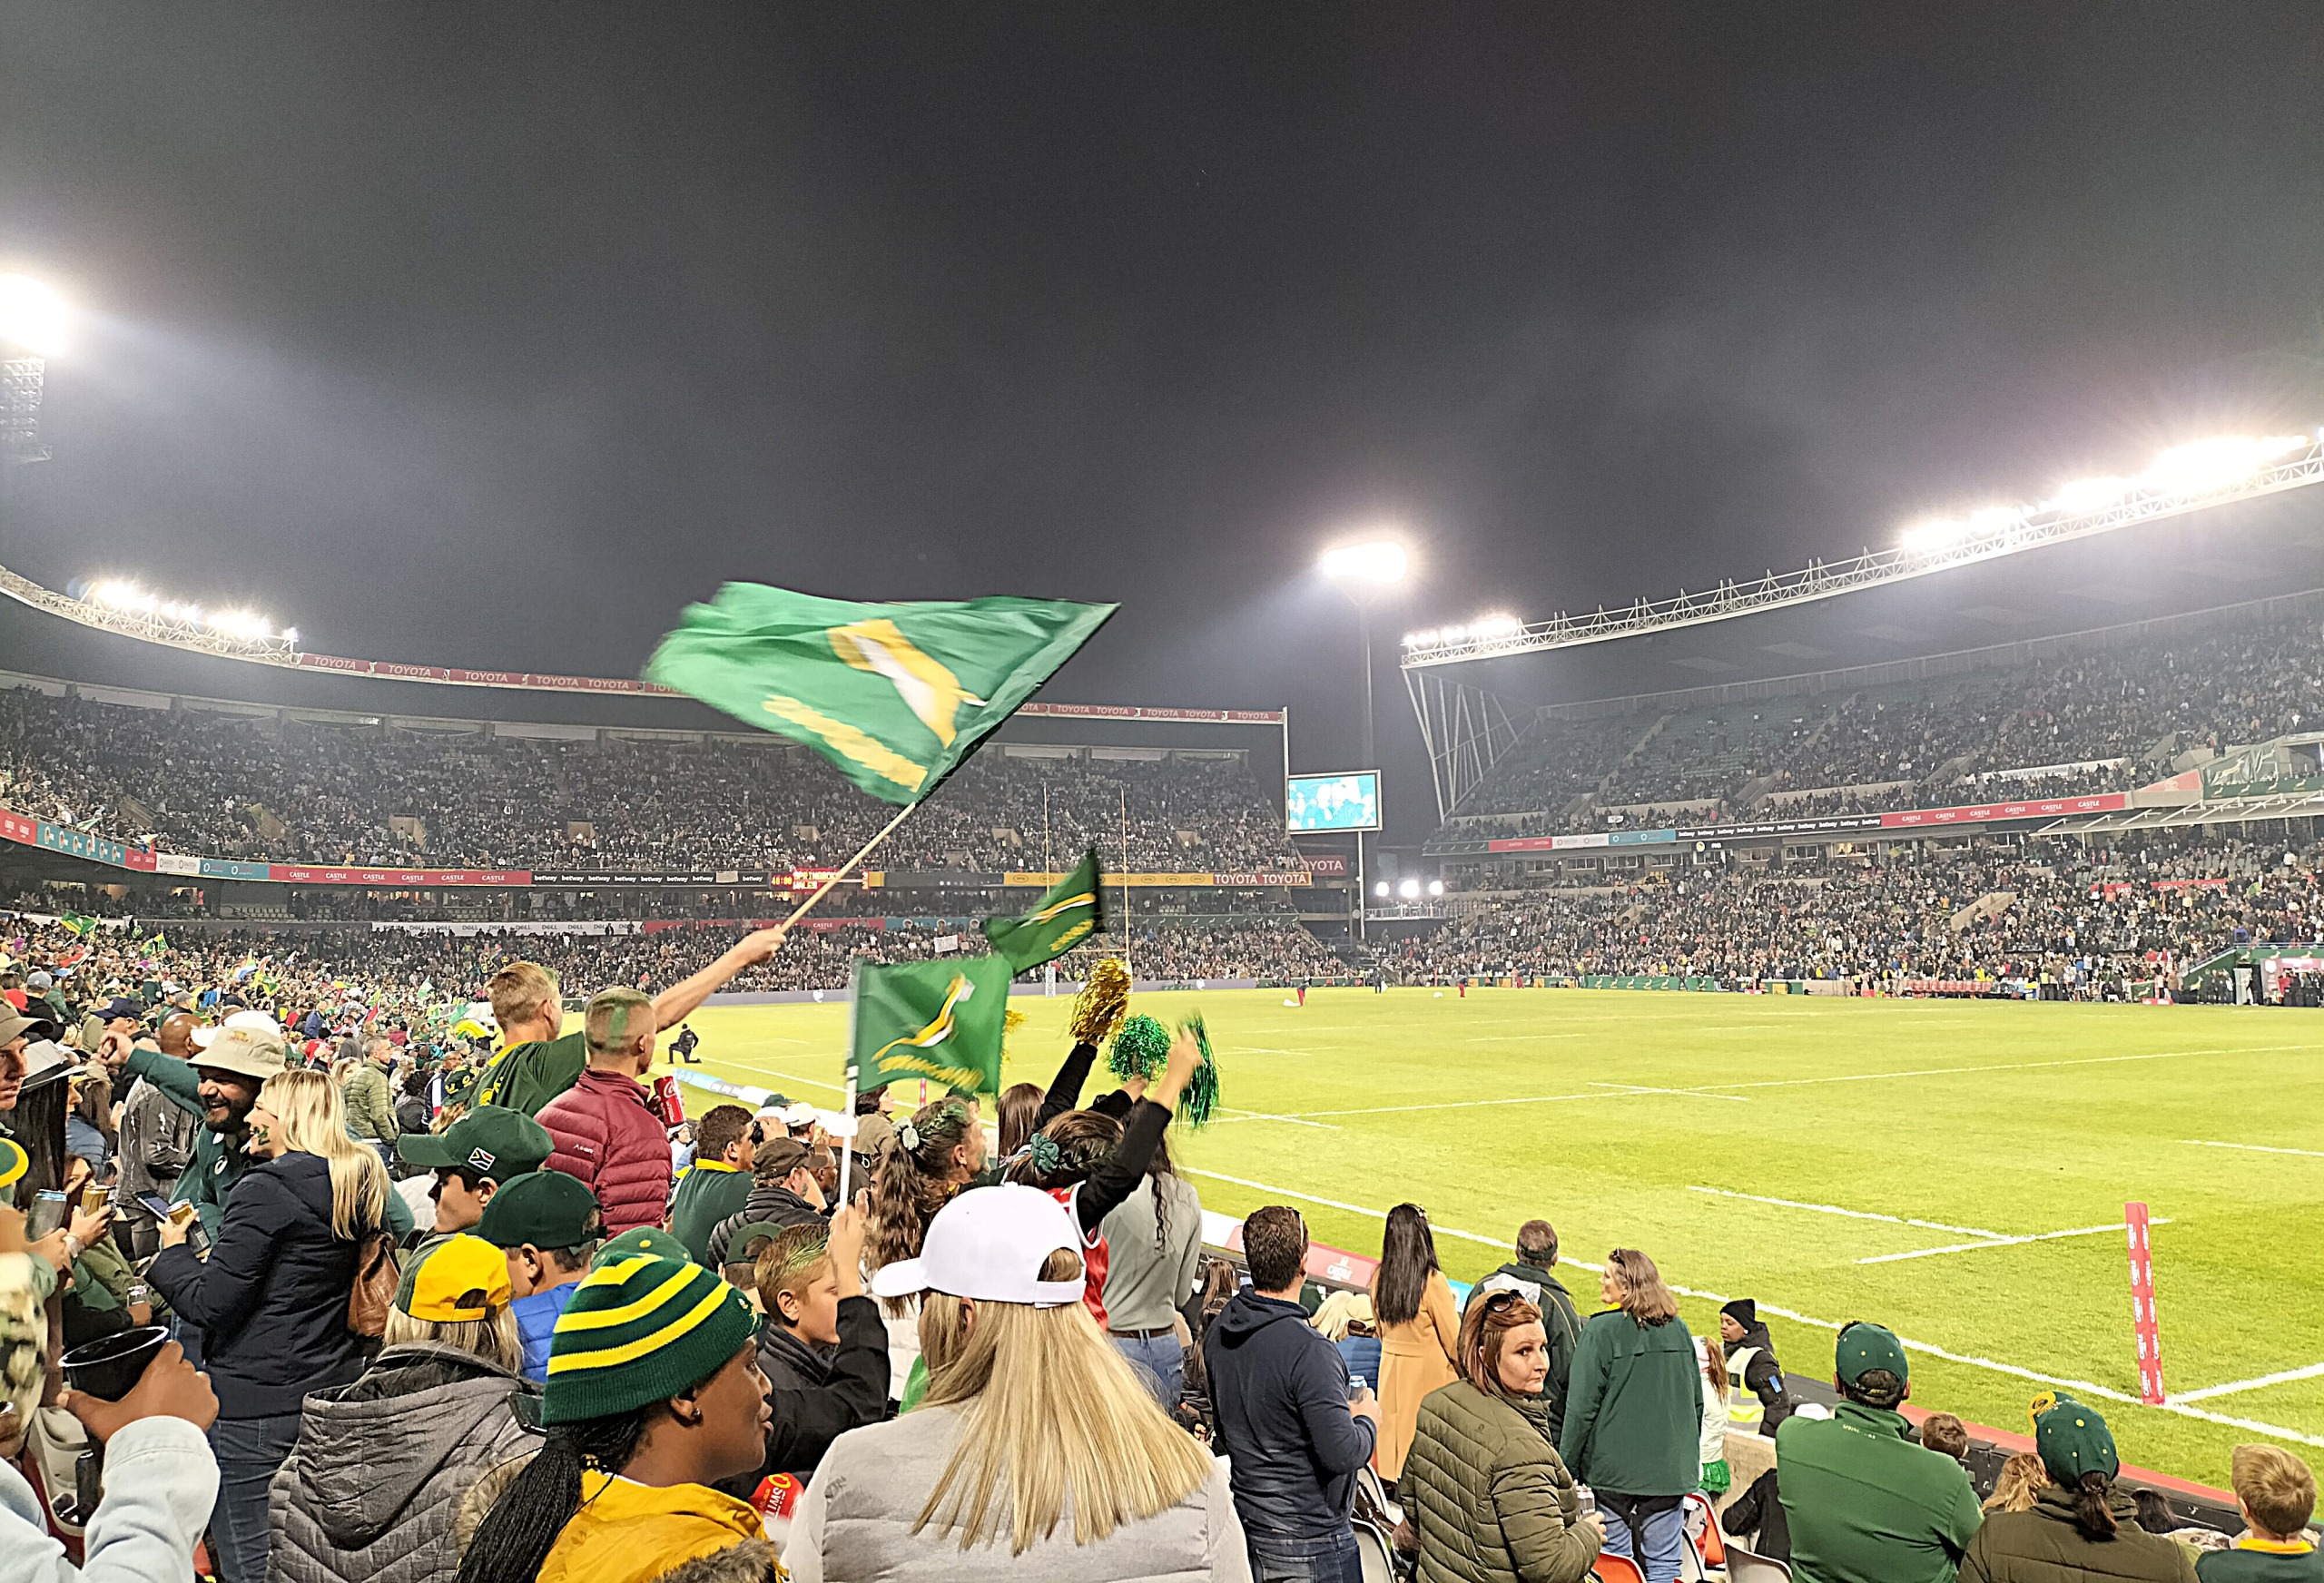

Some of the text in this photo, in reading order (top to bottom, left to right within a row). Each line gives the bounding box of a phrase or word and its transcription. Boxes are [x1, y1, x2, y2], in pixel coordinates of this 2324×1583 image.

[314, 656, 357, 670] TOYOTA
[388, 664, 431, 677] TOYOTA
[464, 672, 508, 683] TOYOTA
[536, 676, 578, 687] TOYOTA
[588, 679, 629, 690] TOYOTA
[1058, 704, 1089, 714] TOYOTA
[1097, 707, 1128, 715] TOYOTA
[1147, 709, 1178, 717] TOYOTA
[1185, 711, 1216, 719] TOYOTA
[1237, 712, 1269, 720] TOYOTA
[793, 871, 842, 880] SPRINGBOK
[1215, 874, 1306, 884] TOYOTA TOYOTA
[2127, 1223, 2136, 1250] CASTLE
[2131, 1260, 2139, 1286] CASTLE
[2133, 1296, 2142, 1322] CASTLE
[2137, 1333, 2145, 1360] CASTLE
[2142, 1370, 2150, 1397] CASTLE
